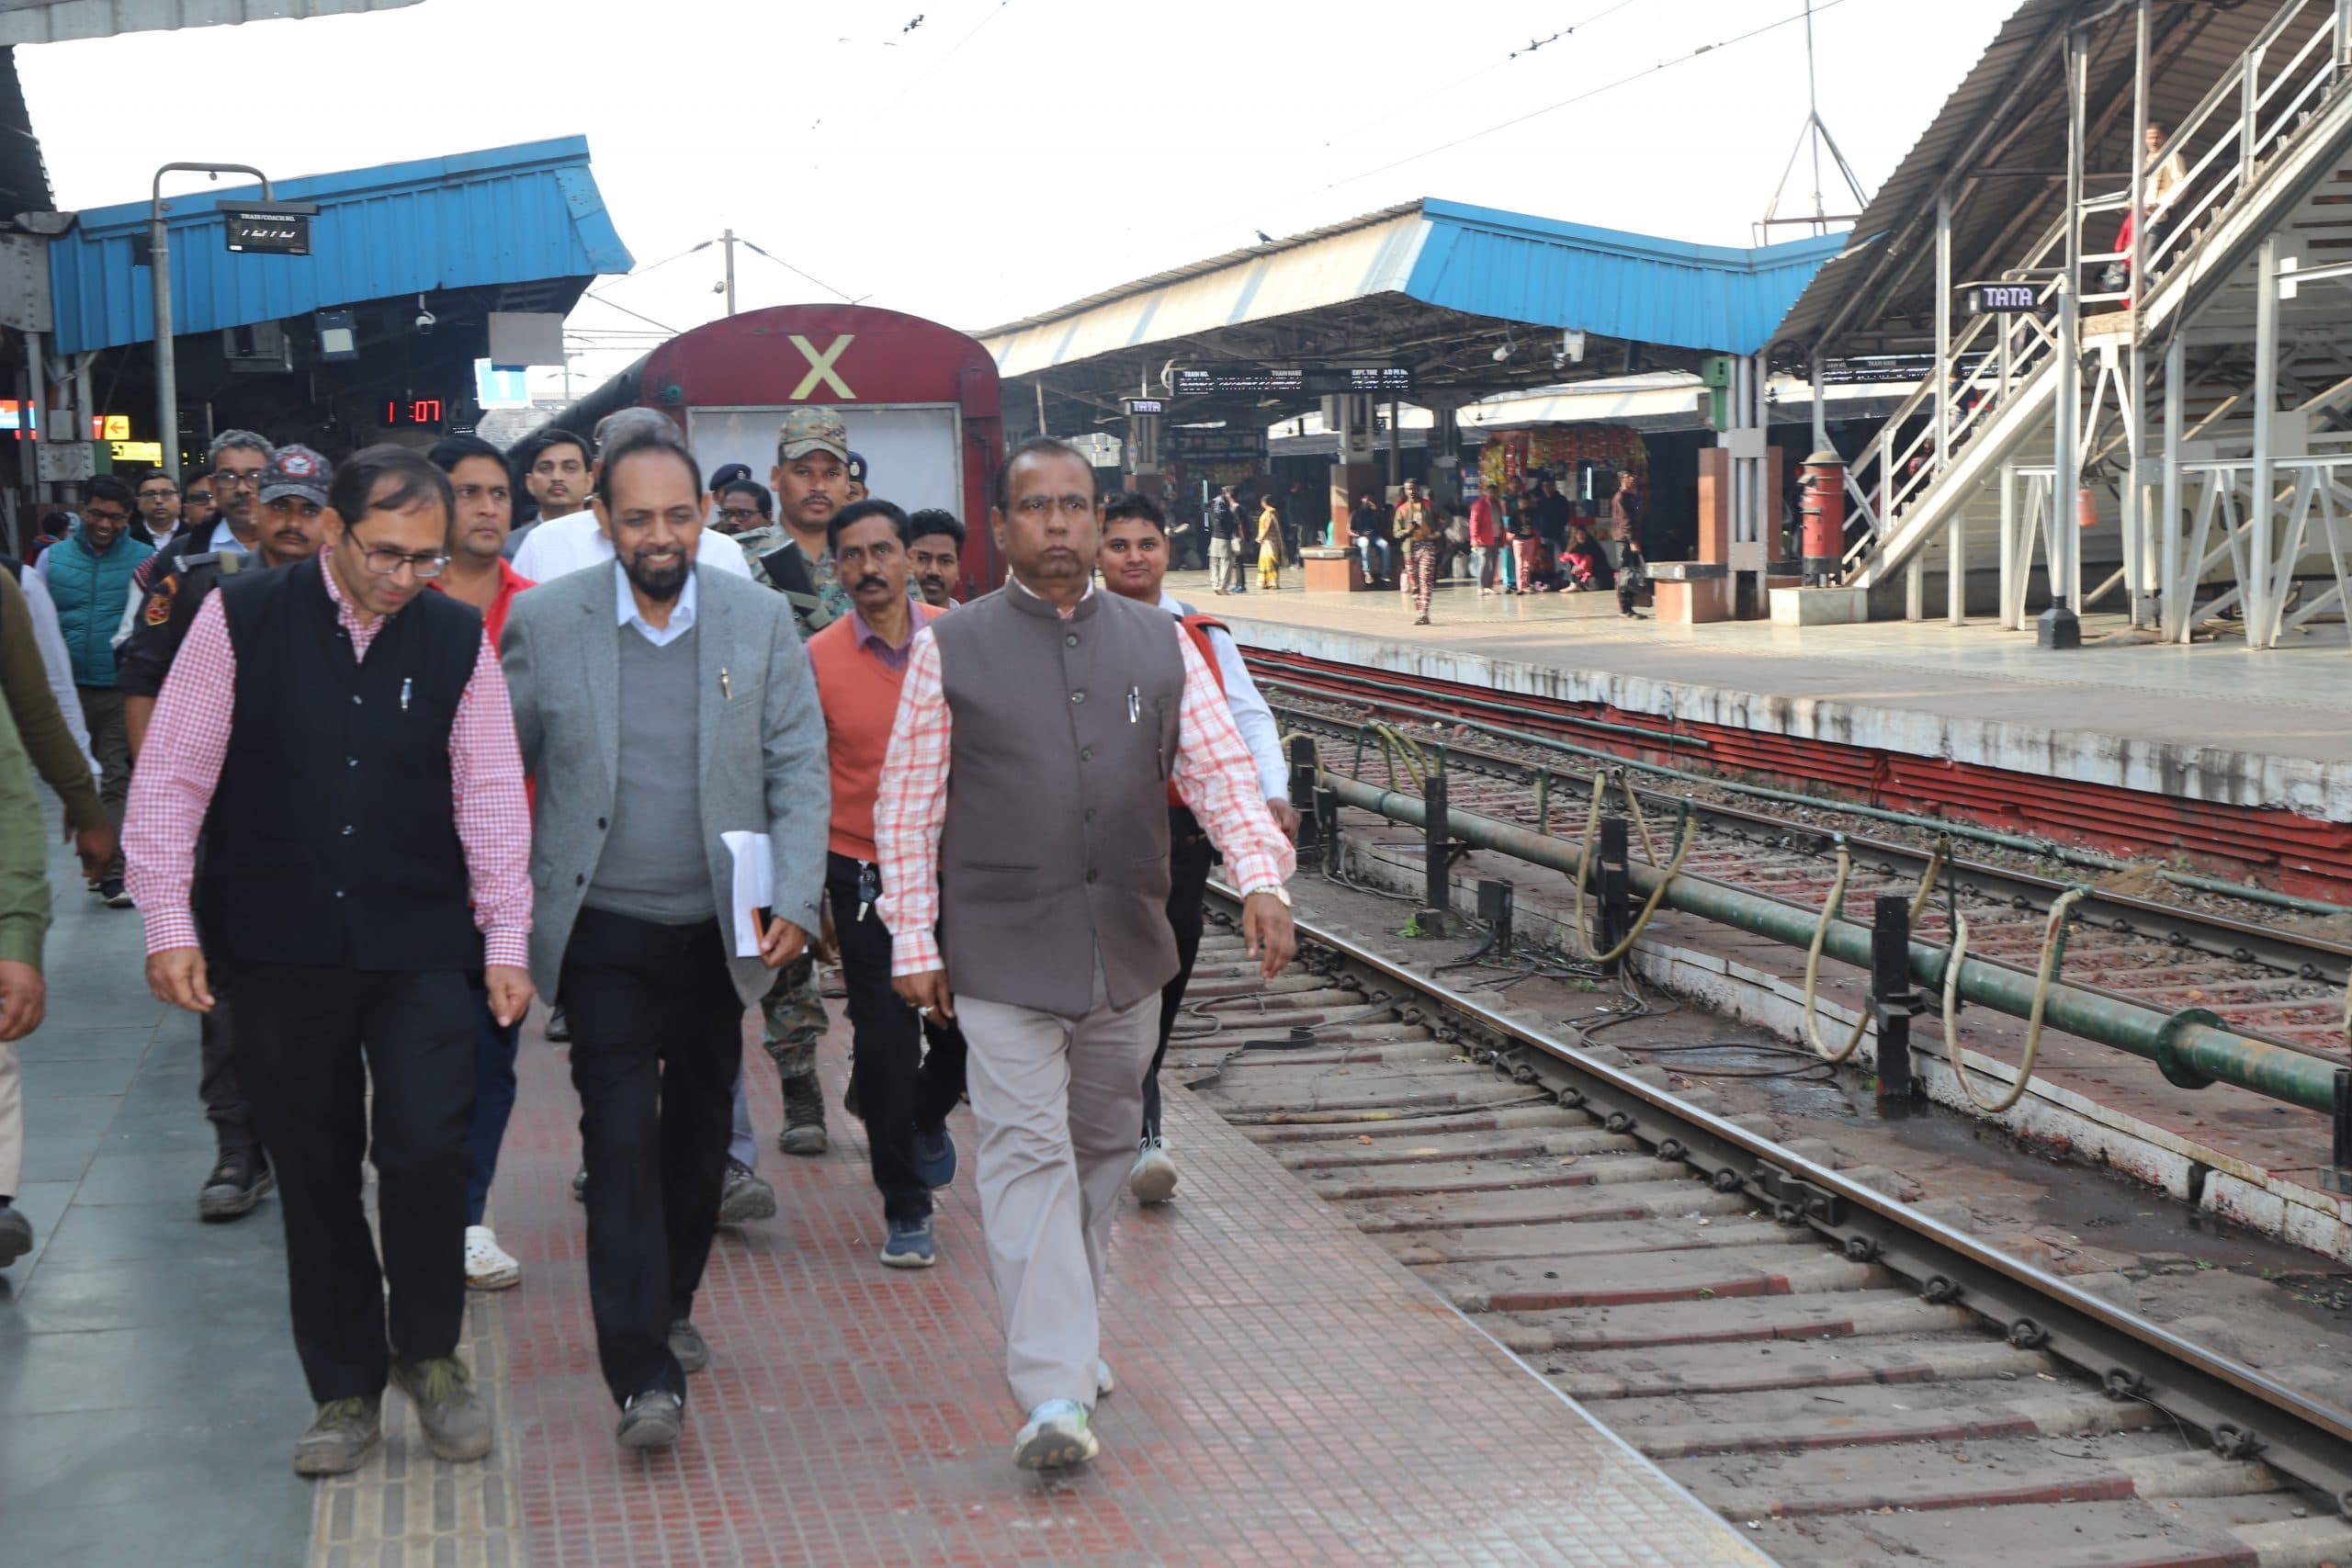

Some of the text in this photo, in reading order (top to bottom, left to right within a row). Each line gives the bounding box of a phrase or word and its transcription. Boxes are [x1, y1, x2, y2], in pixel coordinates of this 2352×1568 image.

[1983, 287, 2033, 307] TATA
[788, 334, 858, 400] X
[1131, 400, 1161, 412] TATA
